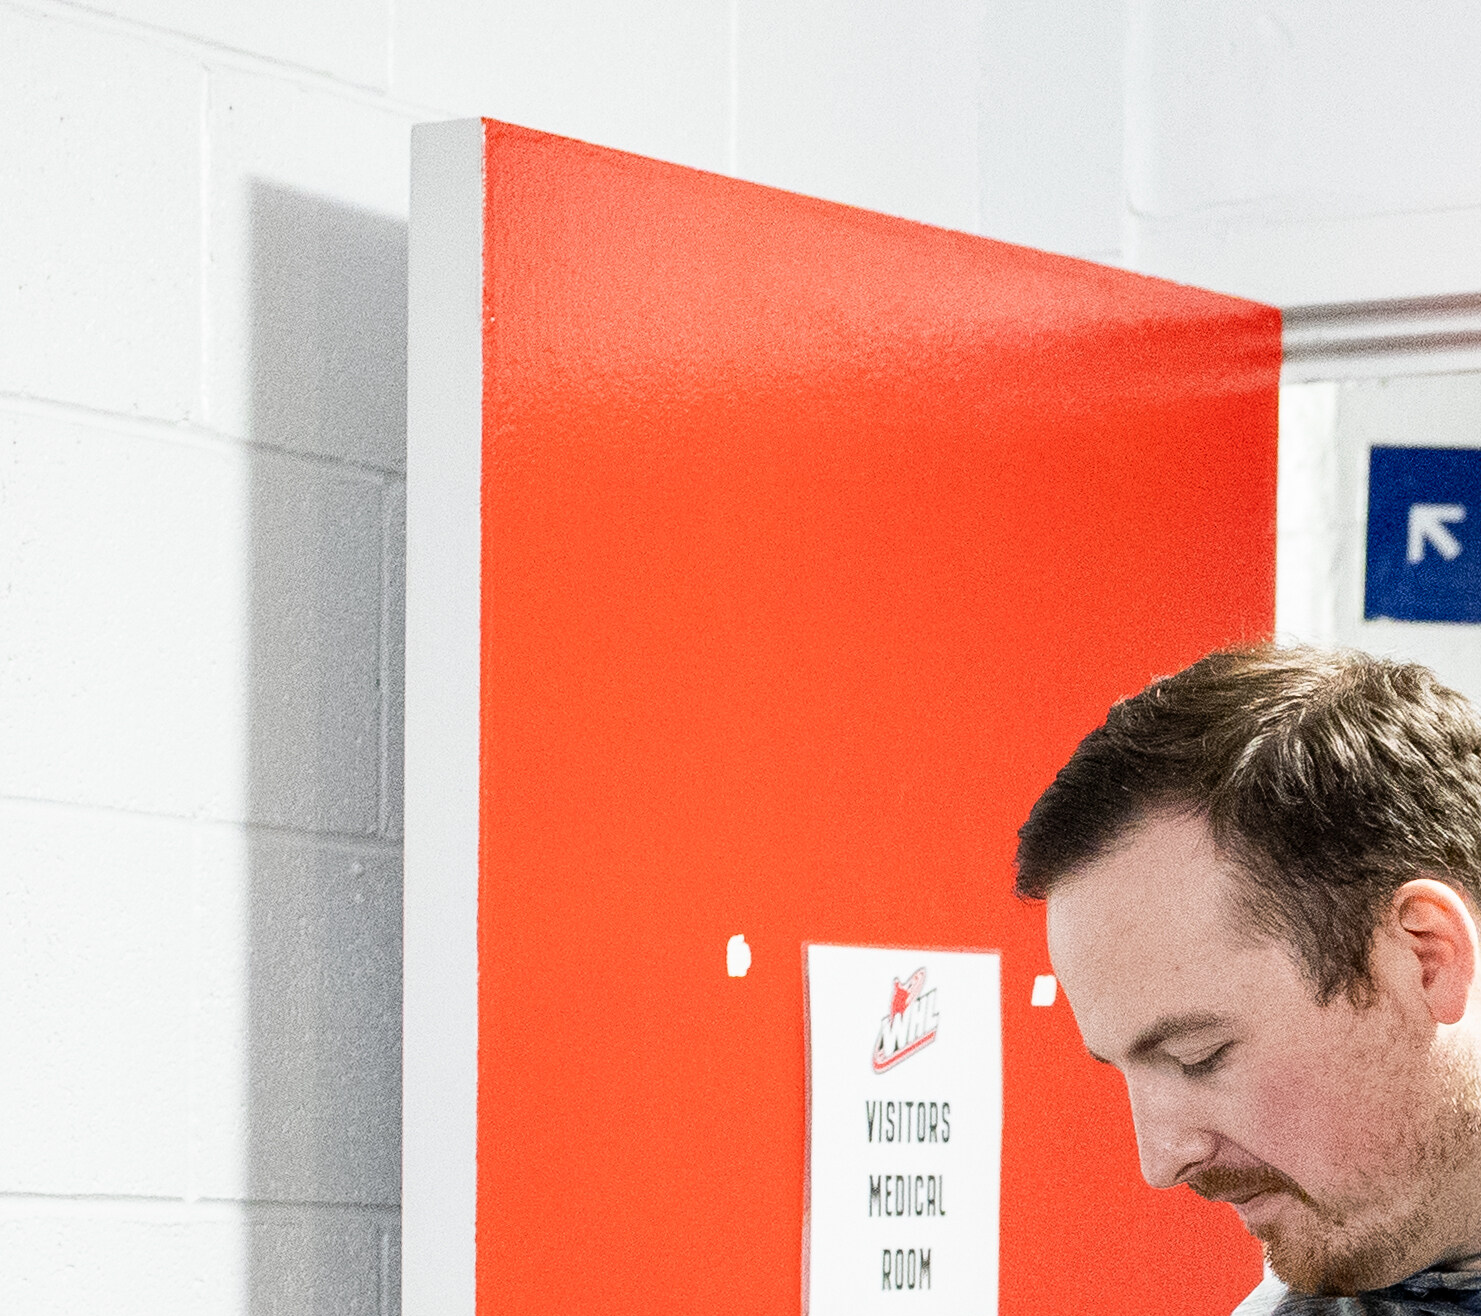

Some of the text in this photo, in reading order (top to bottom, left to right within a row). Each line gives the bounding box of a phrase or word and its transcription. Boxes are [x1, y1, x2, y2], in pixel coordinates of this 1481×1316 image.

[878, 987, 941, 1056] WHL
[865, 1099, 953, 1145] VISITORS
[868, 1173, 948, 1218] MEDICAL
[881, 1247, 932, 1292] ROOM
